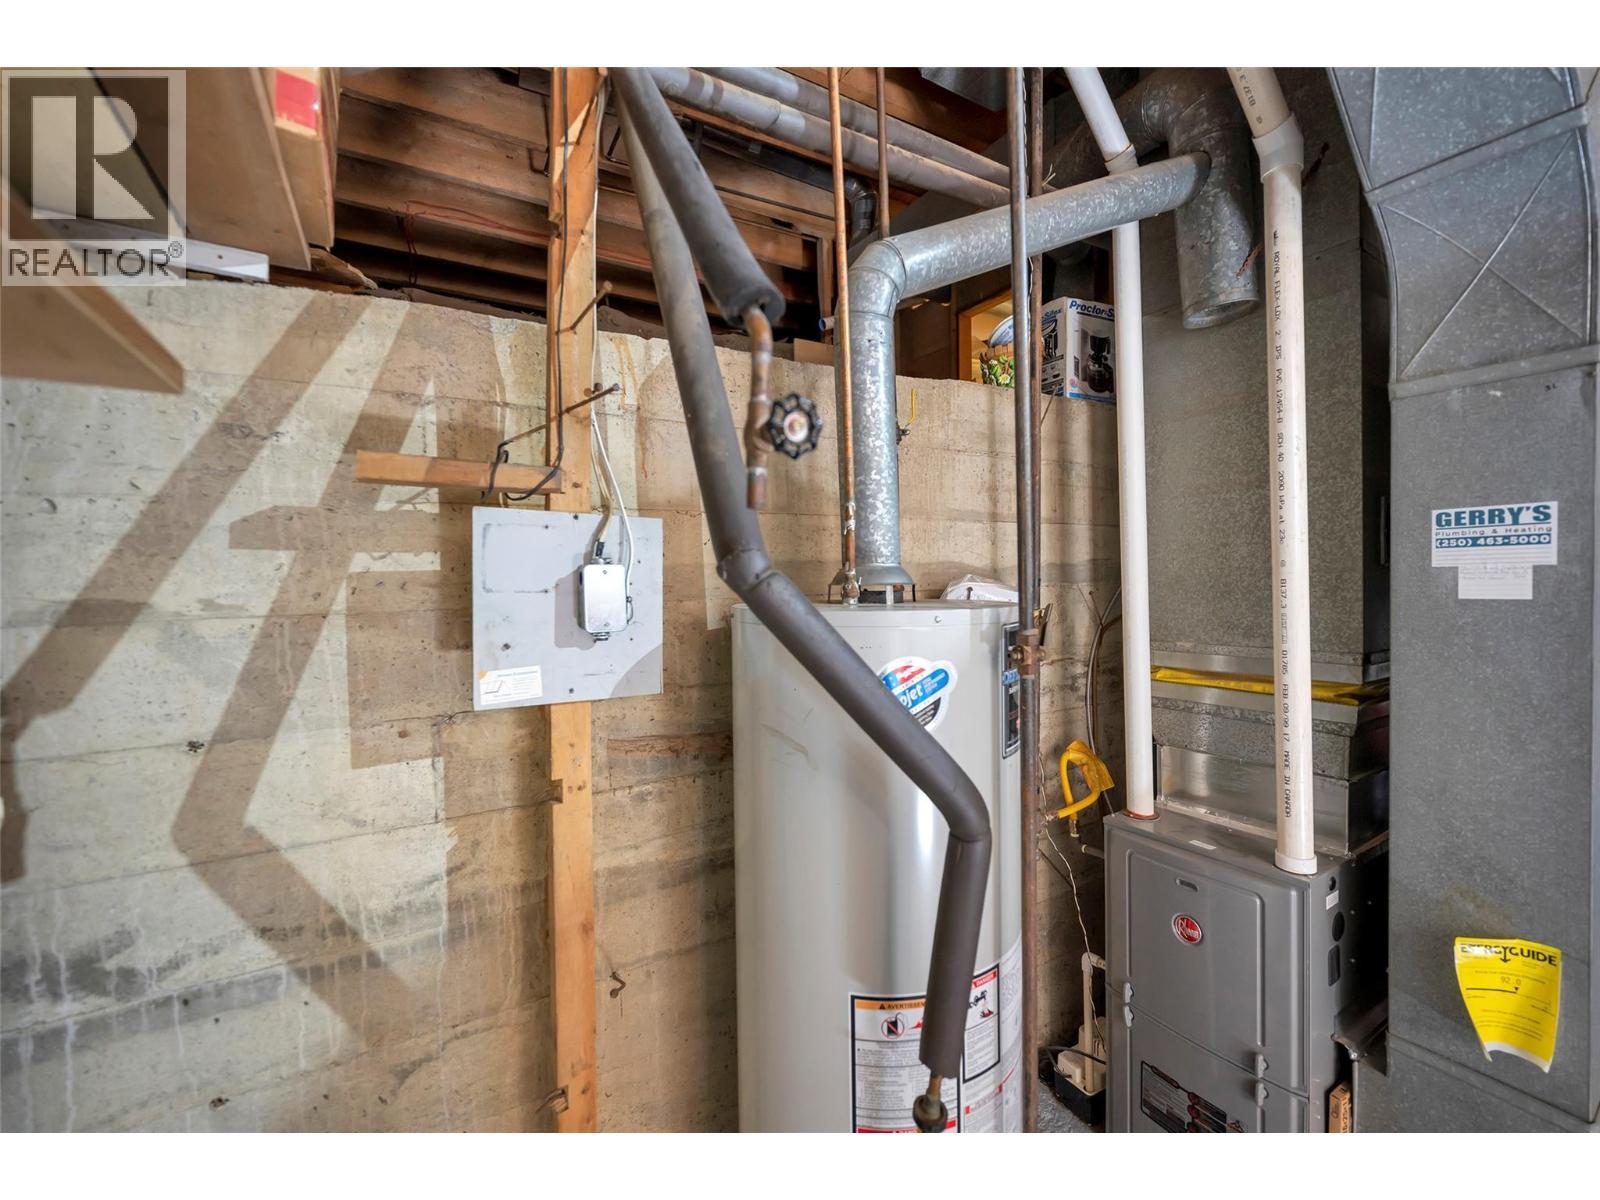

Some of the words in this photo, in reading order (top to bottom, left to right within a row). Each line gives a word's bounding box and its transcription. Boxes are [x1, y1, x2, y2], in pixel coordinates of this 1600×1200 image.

[1273, 250, 1281, 278] ROYAL
[1069, 299, 1115, 318] Proctor-S
[1277, 451, 1285, 463] 40
[1435, 504, 1552, 528] GERRY'S
[1435, 529, 1486, 538] Plumbing
[1504, 526, 1553, 534] Heating
[1435, 538, 1473, 548] (250)
[1476, 535, 1551, 546] 463-5000
[1284, 750, 1292, 770] MADE
[1284, 775, 1292, 785] IN
[1285, 788, 1293, 819] CANADA
